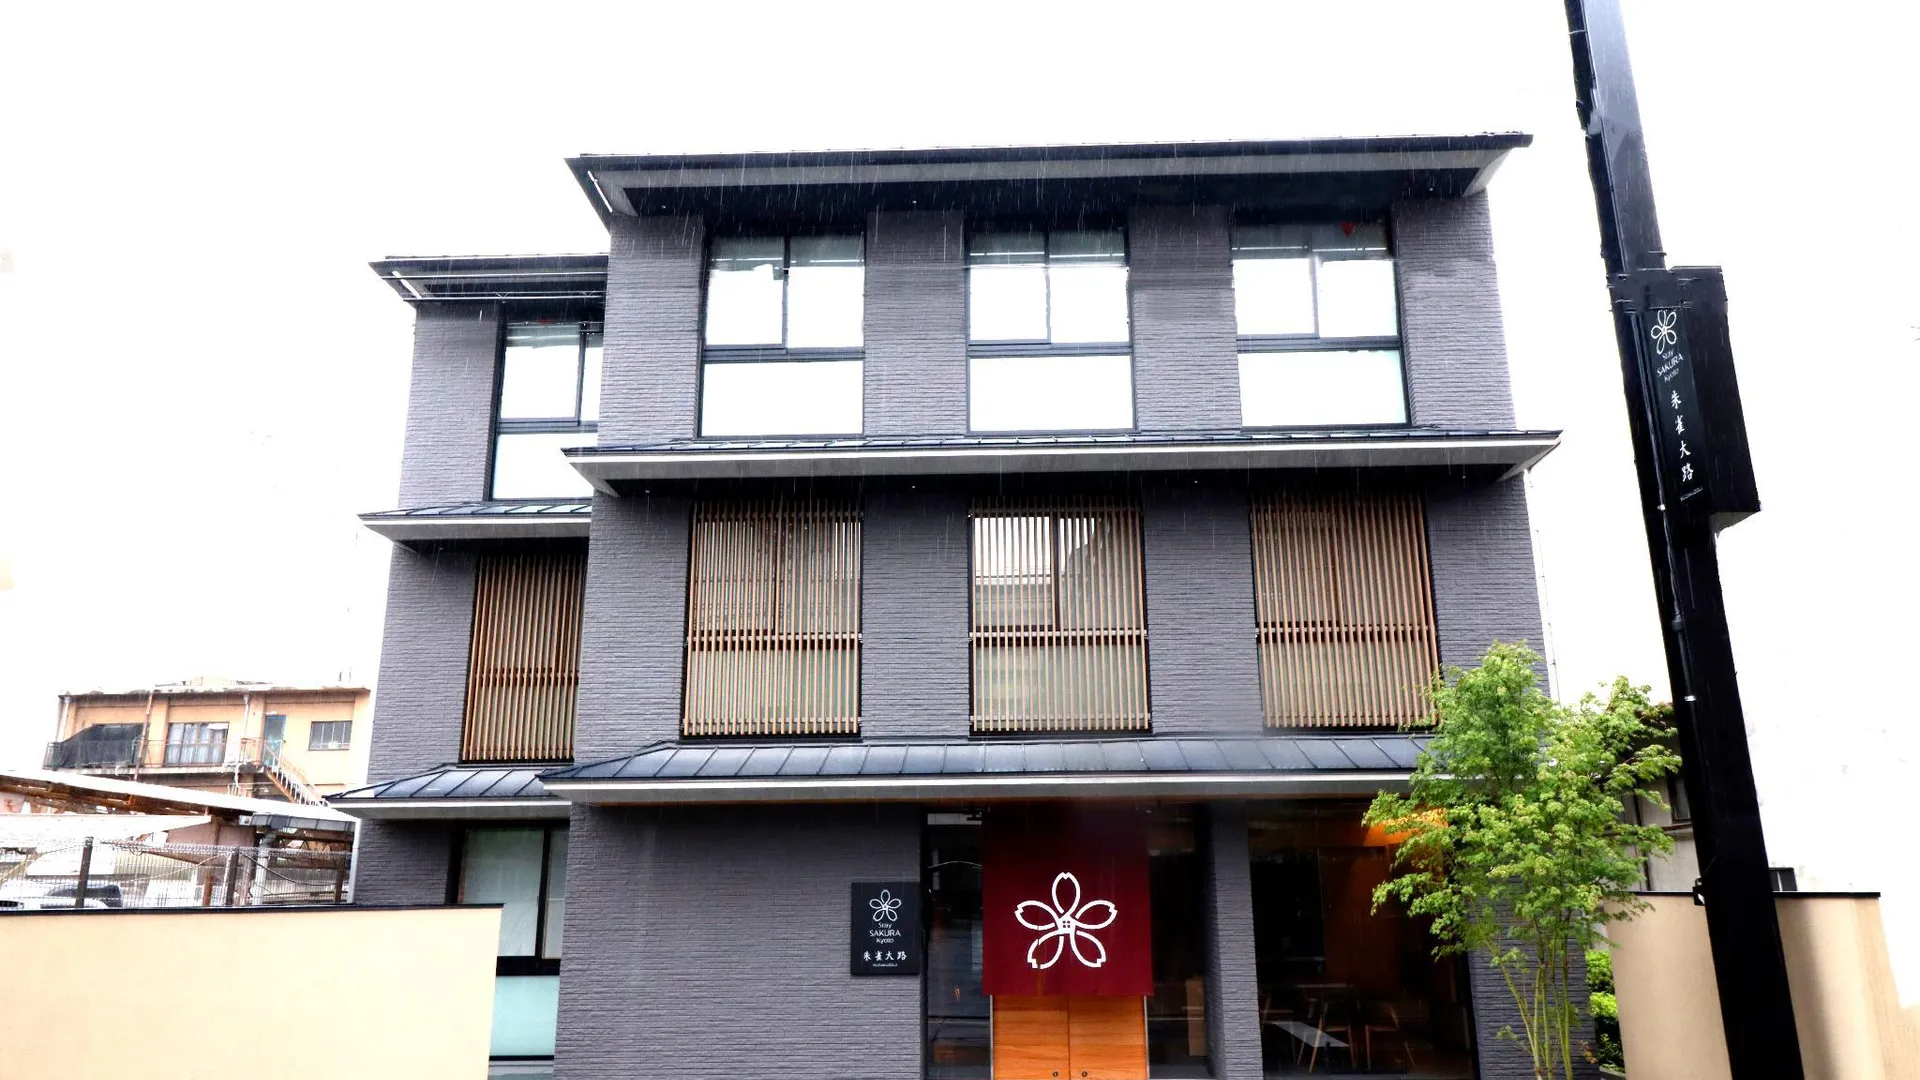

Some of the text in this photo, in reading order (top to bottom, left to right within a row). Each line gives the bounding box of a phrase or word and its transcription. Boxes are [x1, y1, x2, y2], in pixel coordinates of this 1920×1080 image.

[1657, 353, 1683, 376] SAKURA
[1671, 389, 1694, 482] 朱雀大路
[869, 929, 902, 937] SAKURA
[863, 950, 907, 961] 朱雀大路
